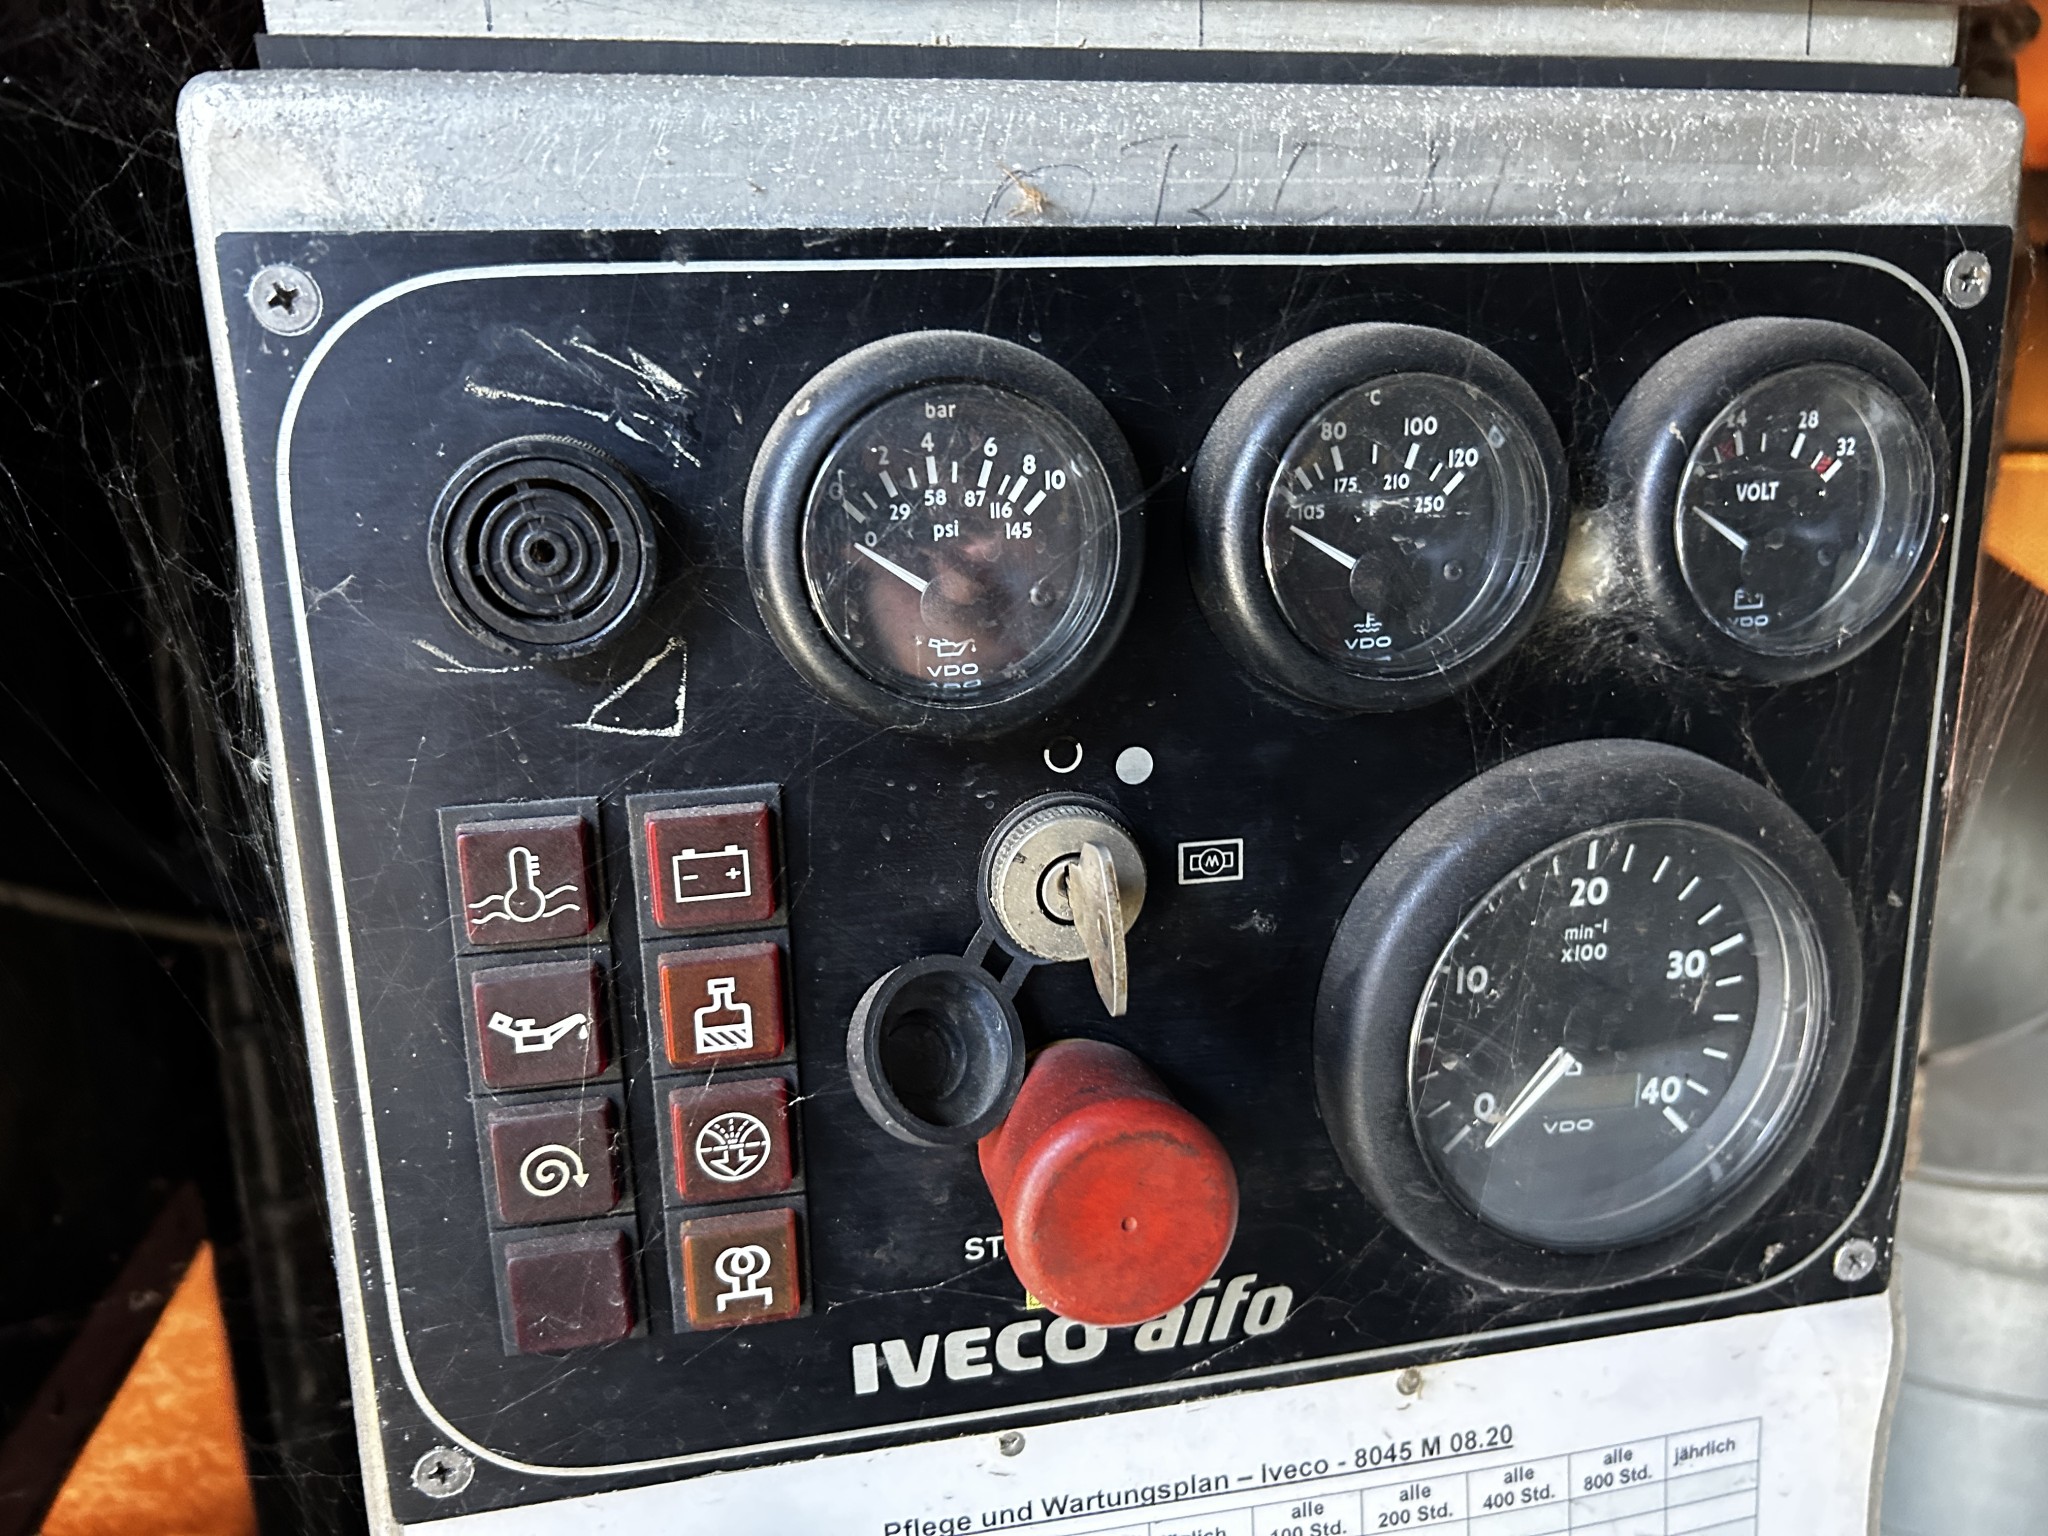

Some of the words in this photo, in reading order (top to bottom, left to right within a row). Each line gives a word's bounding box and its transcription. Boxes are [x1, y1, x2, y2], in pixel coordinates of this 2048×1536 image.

[924, 401, 956, 419] bar
[1320, 421, 1347, 441] 80
[1404, 416, 1438, 436] 100
[1448, 448, 1479, 468] 120
[1798, 410, 1820, 429] 28
[1836, 437, 1857, 457] 32
[877, 445, 890, 465] 2
[920, 432, 934, 451] 4
[983, 437, 998, 457] 6
[1022, 454, 1037, 475] 8
[1044, 469, 1066, 491] 10
[1333, 477, 1358, 493] 175
[1383, 473, 1410, 490] 210
[1414, 496, 1445, 513] 250
[1736, 481, 1780, 502] VOLT
[864, 530, 878, 548] 0
[889, 504, 911, 521] 29
[924, 489, 947, 506] 58
[963, 489, 986, 507] 87
[989, 501, 1013, 519] 116
[1004, 523, 1032, 539] 145
[932, 519, 959, 541] psi
[1727, 614, 1769, 627] VDO
[1344, 635, 1392, 650] VDO
[926, 663, 979, 678] VDO
[1569, 877, 1609, 907] 20
[1560, 943, 1608, 964] x100
[1666, 949, 1707, 981] 30
[1455, 964, 1489, 996] 10
[1640, 1075, 1682, 1106] 40
[1473, 1092, 1496, 1121] 0
[1542, 1118, 1595, 1135] VDO
[964, 1235, 1004, 1260] ST
[852, 1315, 1108, 1395] IVECO
[1603, 1448, 1634, 1466] alle
[1672, 1438, 1737, 1467] jährlich
[884, 1514, 972, 1536] Pflege
[982, 1500, 1032, 1528] und
[1041, 1473, 1230, 1518] Wartungsplan
[1261, 1459, 1329, 1484] Iveco
[1354, 1440, 1413, 1469] 8045
[1420, 1435, 1442, 1459] M
[1449, 1423, 1514, 1453] 08.20
[1503, 1466, 1536, 1485] alle
[1583, 1471, 1615, 1492] 800
[1619, 1464, 1653, 1486] Std.
[1398, 1483, 1432, 1502] alle
[1482, 1491, 1515, 1511] 400
[1520, 1484, 1556, 1505] Std.
[1290, 1500, 1325, 1520] alle
[1378, 1509, 1411, 1529] 200
[1416, 1502, 1454, 1522] Std.
[1309, 1519, 1348, 1536] Std.
